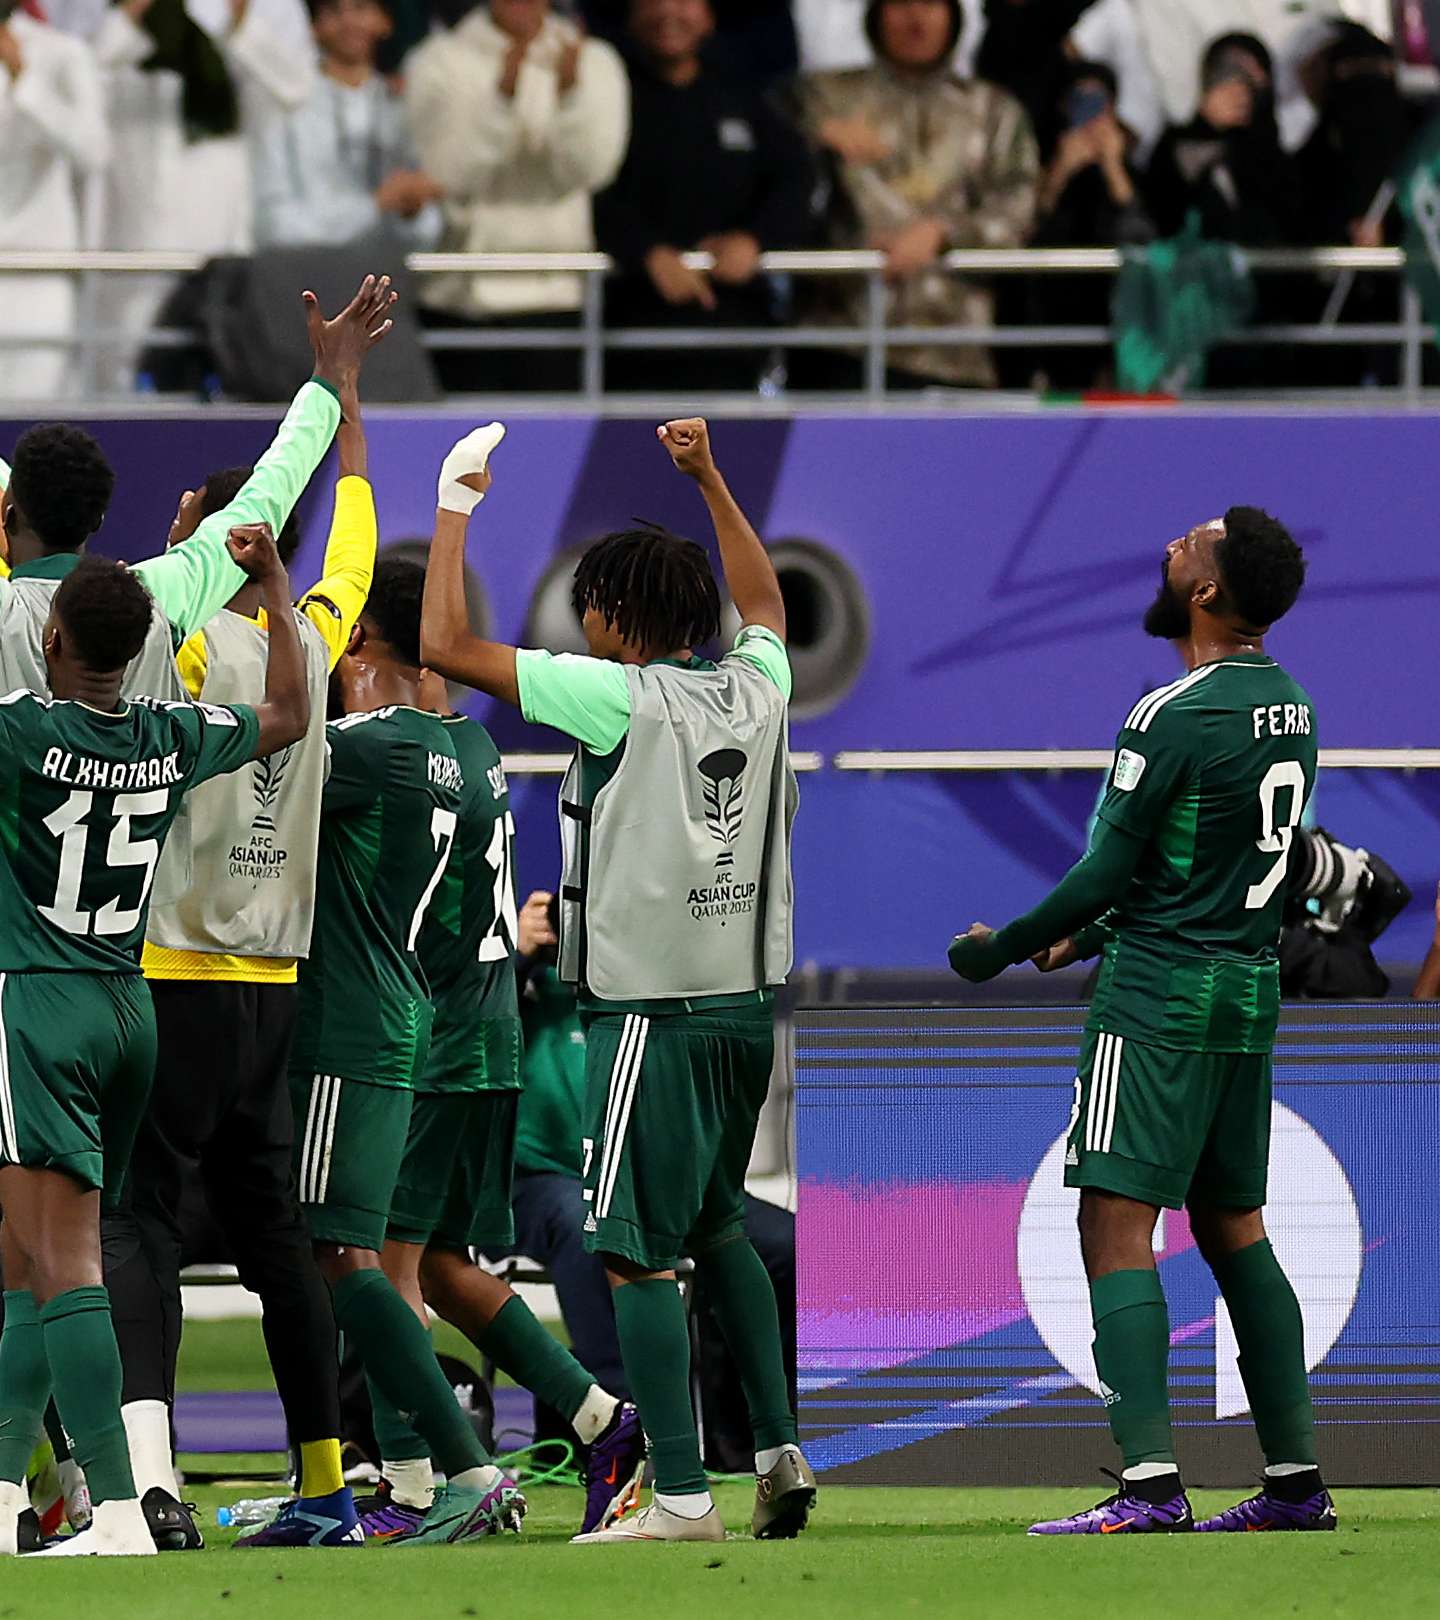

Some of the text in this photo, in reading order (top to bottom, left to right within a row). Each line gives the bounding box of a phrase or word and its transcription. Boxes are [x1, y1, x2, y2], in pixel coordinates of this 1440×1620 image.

[1252, 703, 1310, 739] FERAS
[250, 835, 273, 849] AFC
[1244, 760, 1306, 909] 9
[36, 787, 170, 936] 15
[228, 845, 268, 866] ASIAN
[228, 862, 262, 879] QATAR
[406, 806, 458, 952] 7
[715, 872, 733, 885] AFC
[686, 882, 756, 904] ASIAN CUP
[691, 903, 728, 921] QATAR
